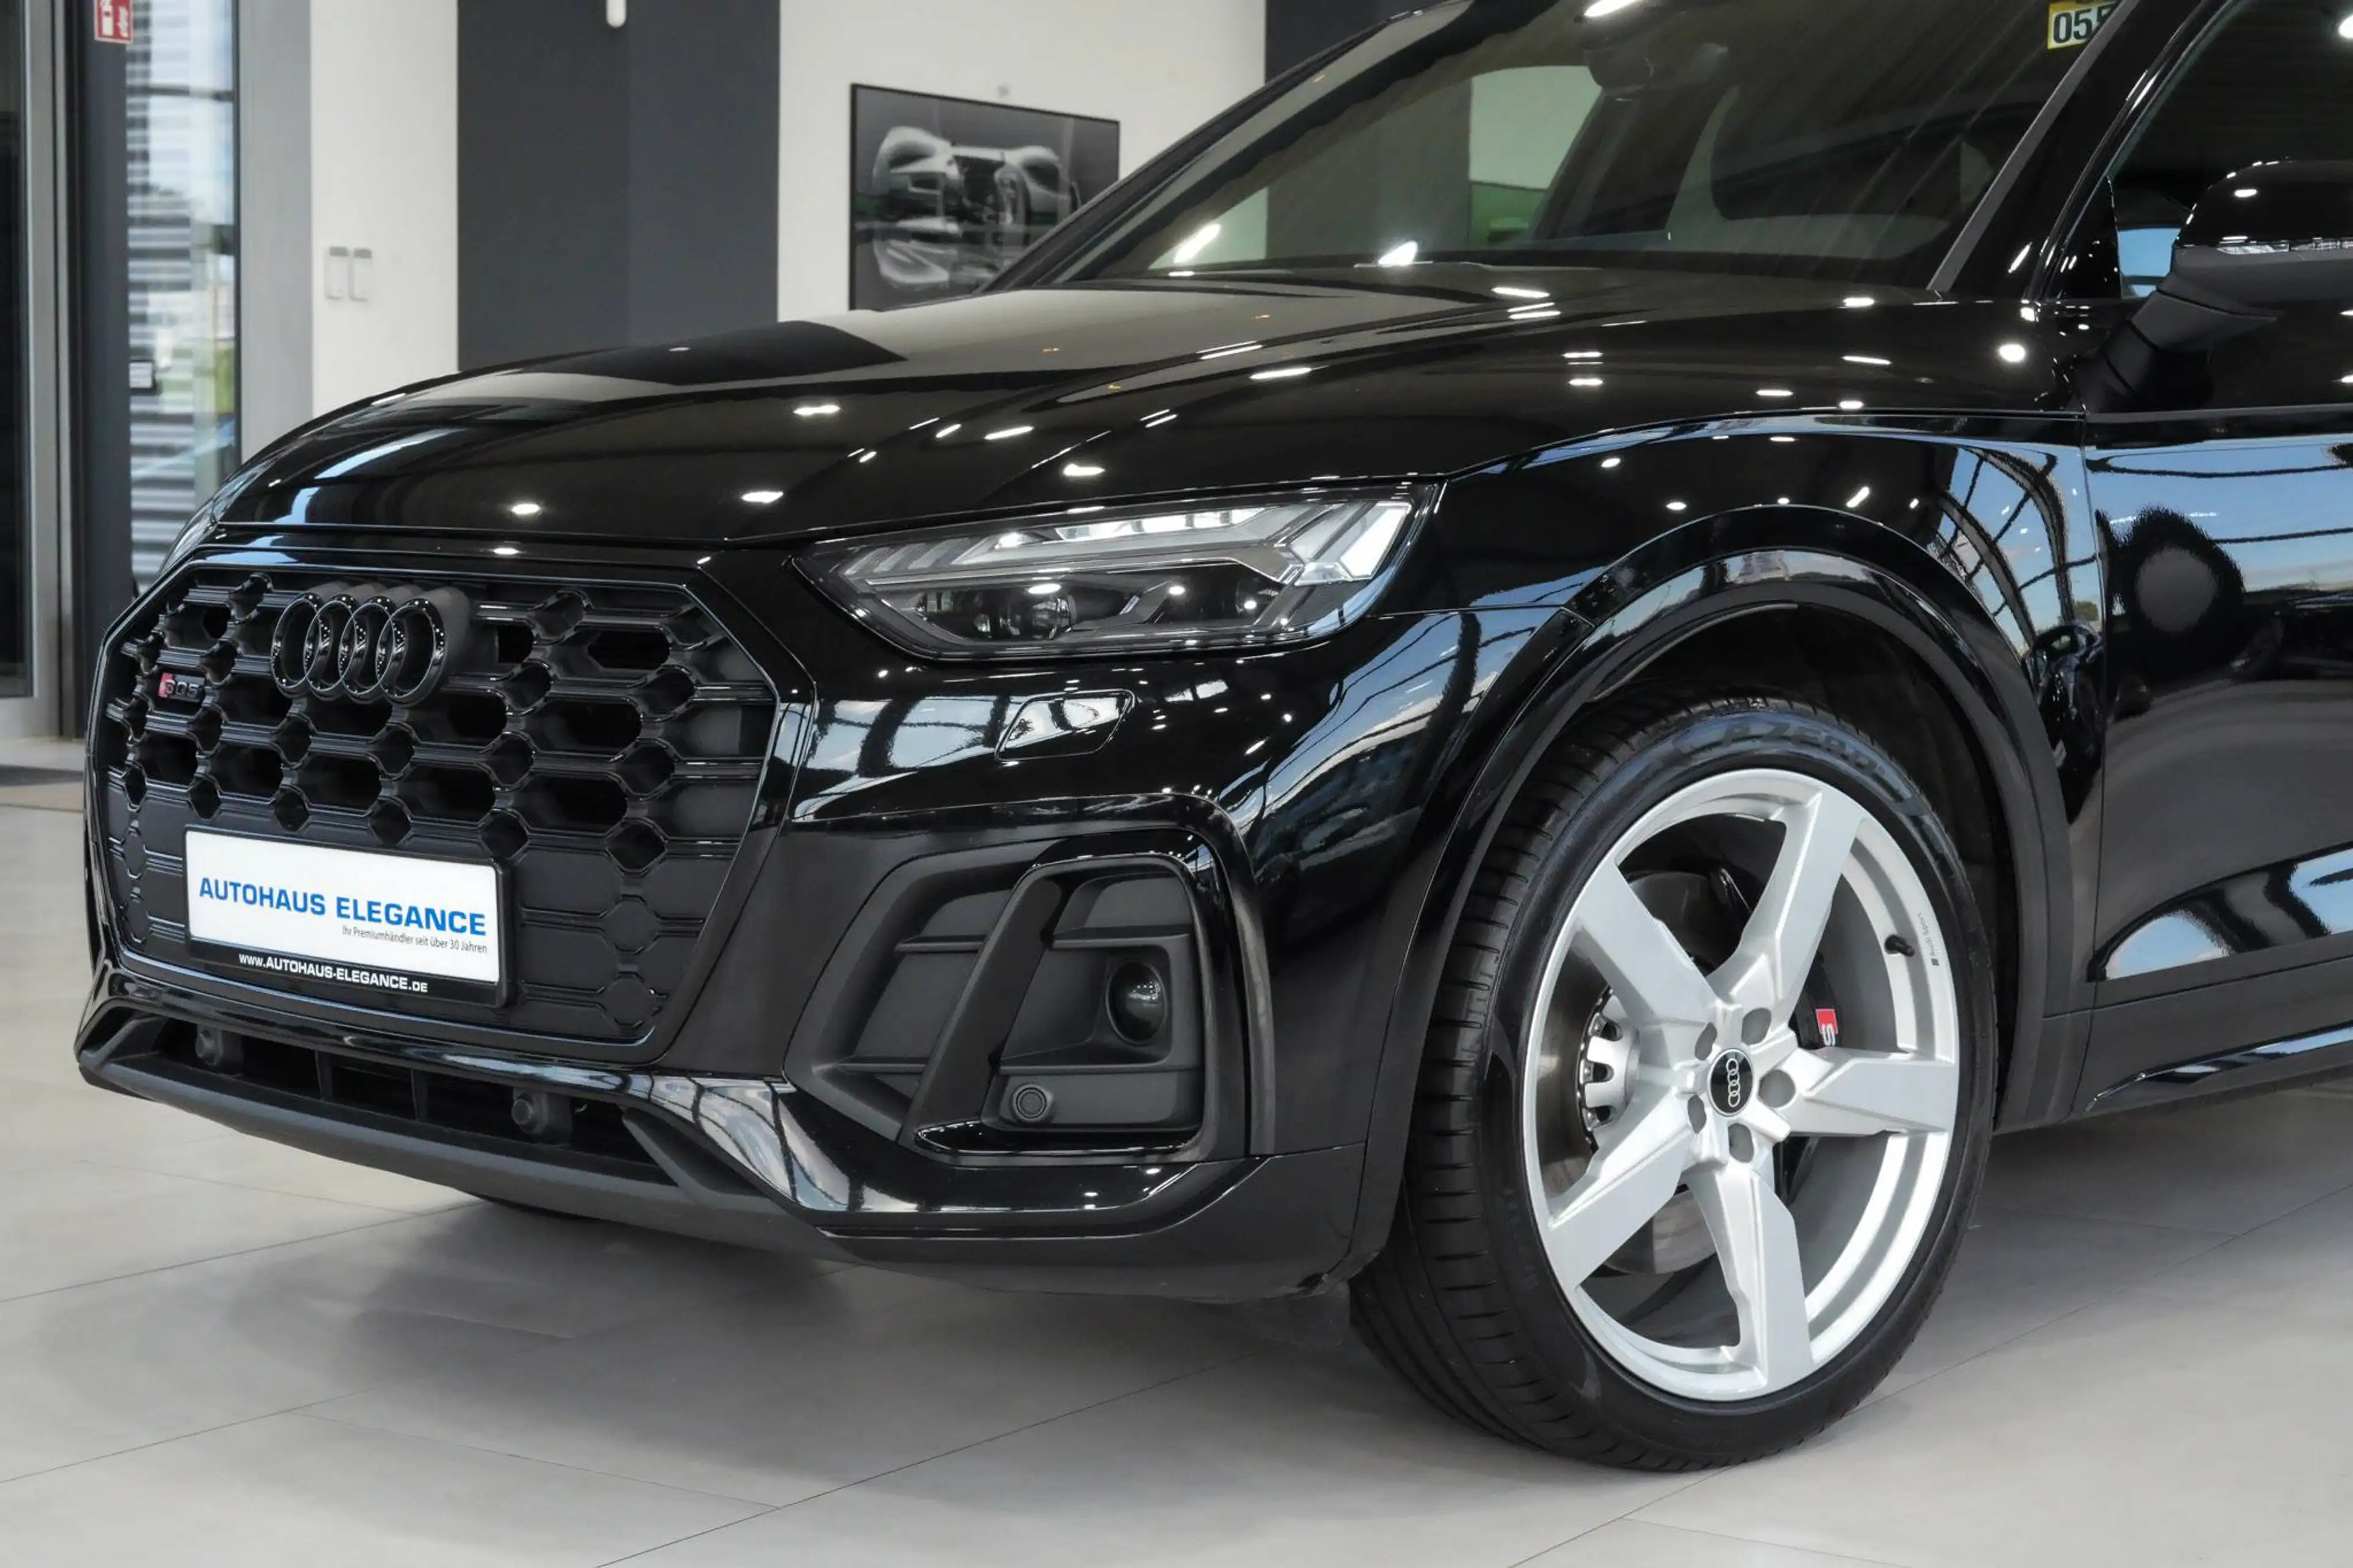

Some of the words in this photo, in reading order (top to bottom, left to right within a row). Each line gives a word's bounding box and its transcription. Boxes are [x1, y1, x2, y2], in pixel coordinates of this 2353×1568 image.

[199, 877, 325, 916] AUTOHAUS
[336, 896, 487, 936] ELEGANCE
[343, 925, 352, 936] Ihr
[353, 926, 414, 944] Premiumhändler
[415, 935, 429, 946] seit
[430, 936, 448, 949] über
[449, 939, 460, 950] 30
[460, 941, 488, 955] Jahren
